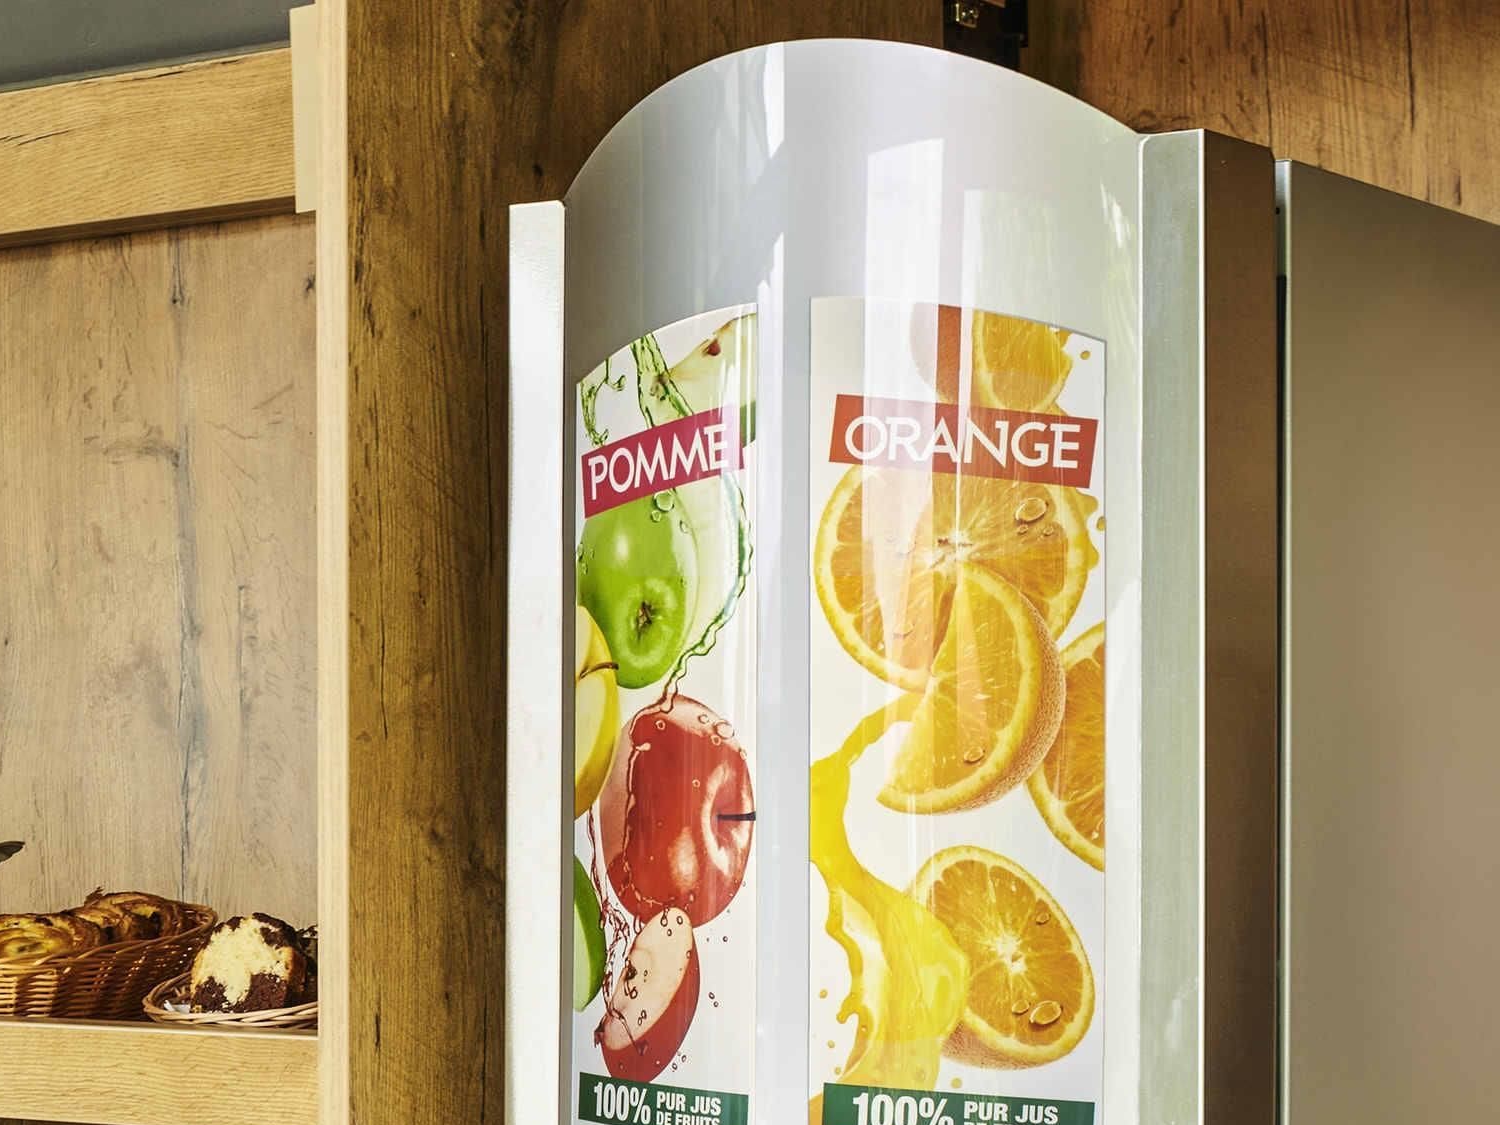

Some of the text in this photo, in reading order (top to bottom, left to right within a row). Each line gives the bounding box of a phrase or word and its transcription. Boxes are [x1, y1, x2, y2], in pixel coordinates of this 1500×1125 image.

[588, 424, 729, 500] POMME
[844, 415, 1081, 469] ORANGE
[594, 1081, 721, 1125] 100% PUR JUS
[963, 1101, 1008, 1122] PUR
[1016, 1104, 1059, 1125] JUS
